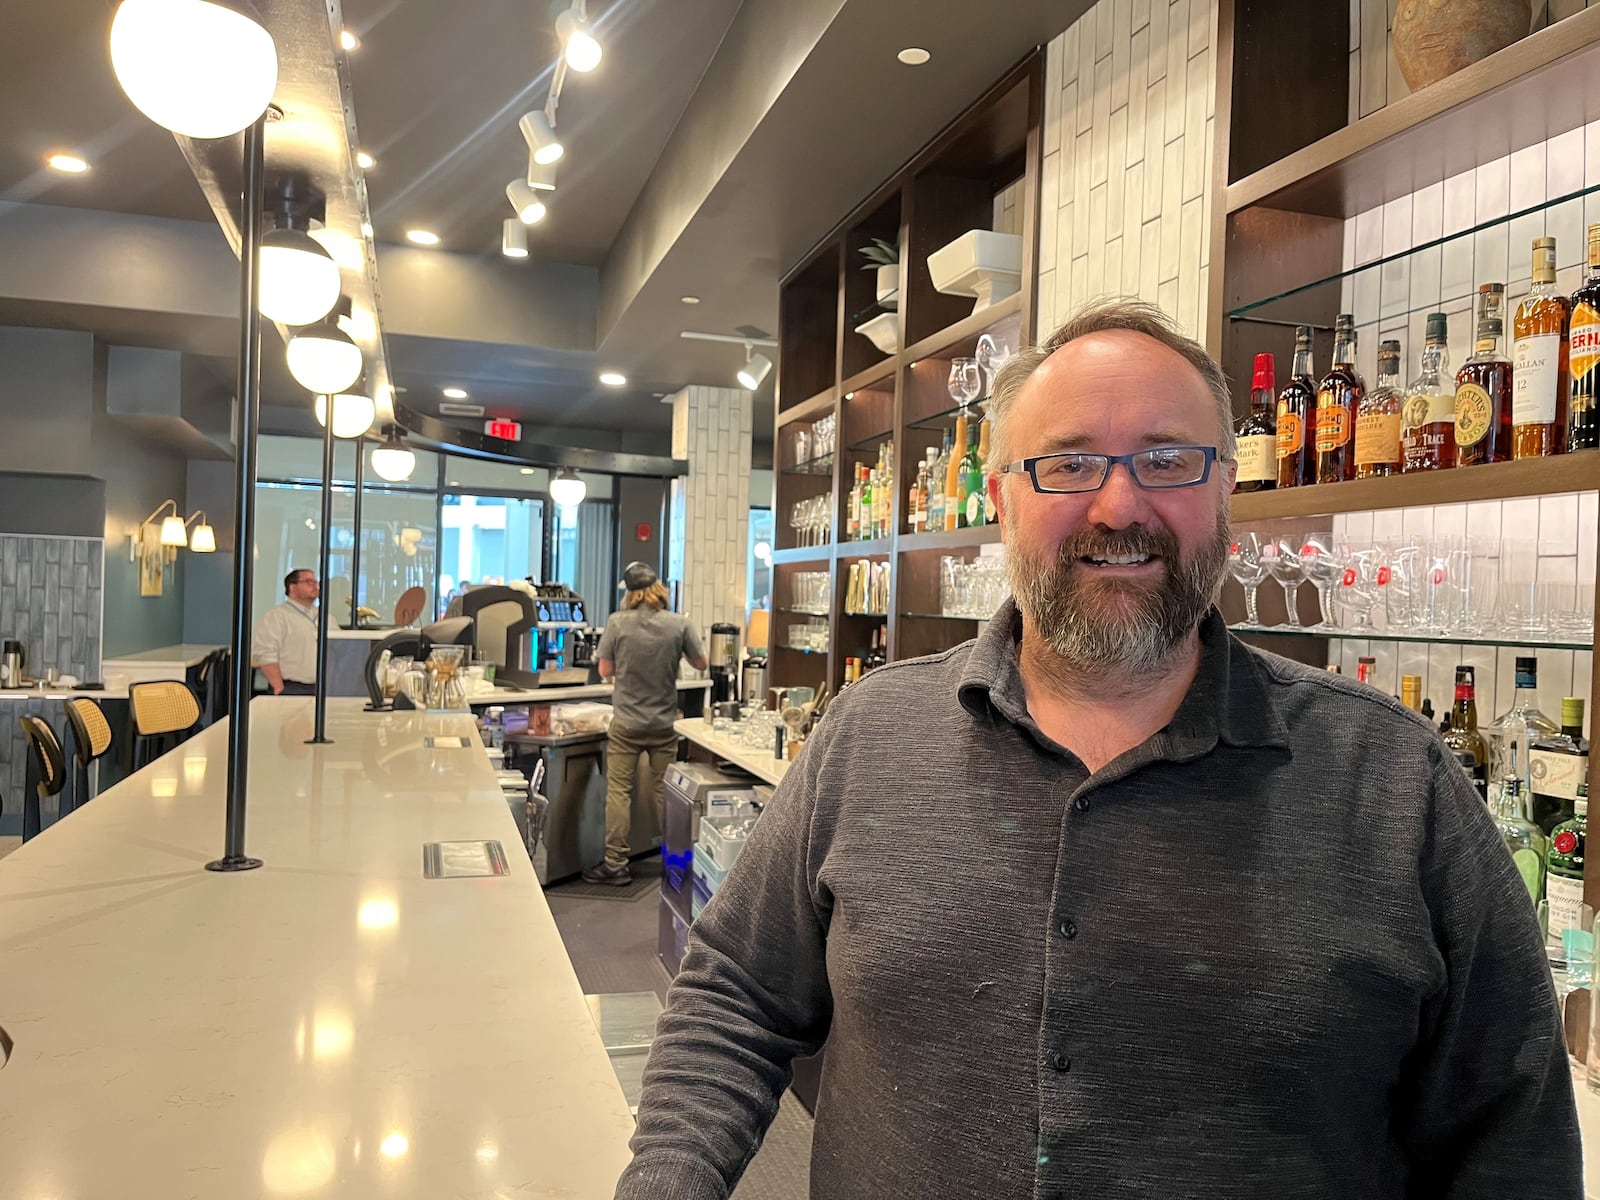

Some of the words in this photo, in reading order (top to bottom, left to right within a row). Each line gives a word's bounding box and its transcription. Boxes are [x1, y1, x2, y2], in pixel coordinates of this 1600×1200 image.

[1571, 332, 1600, 349] ERN
[1517, 379, 1527, 391] 12
[491, 421, 517, 440] EXIT
[1422, 433, 1445, 446] TRACE
